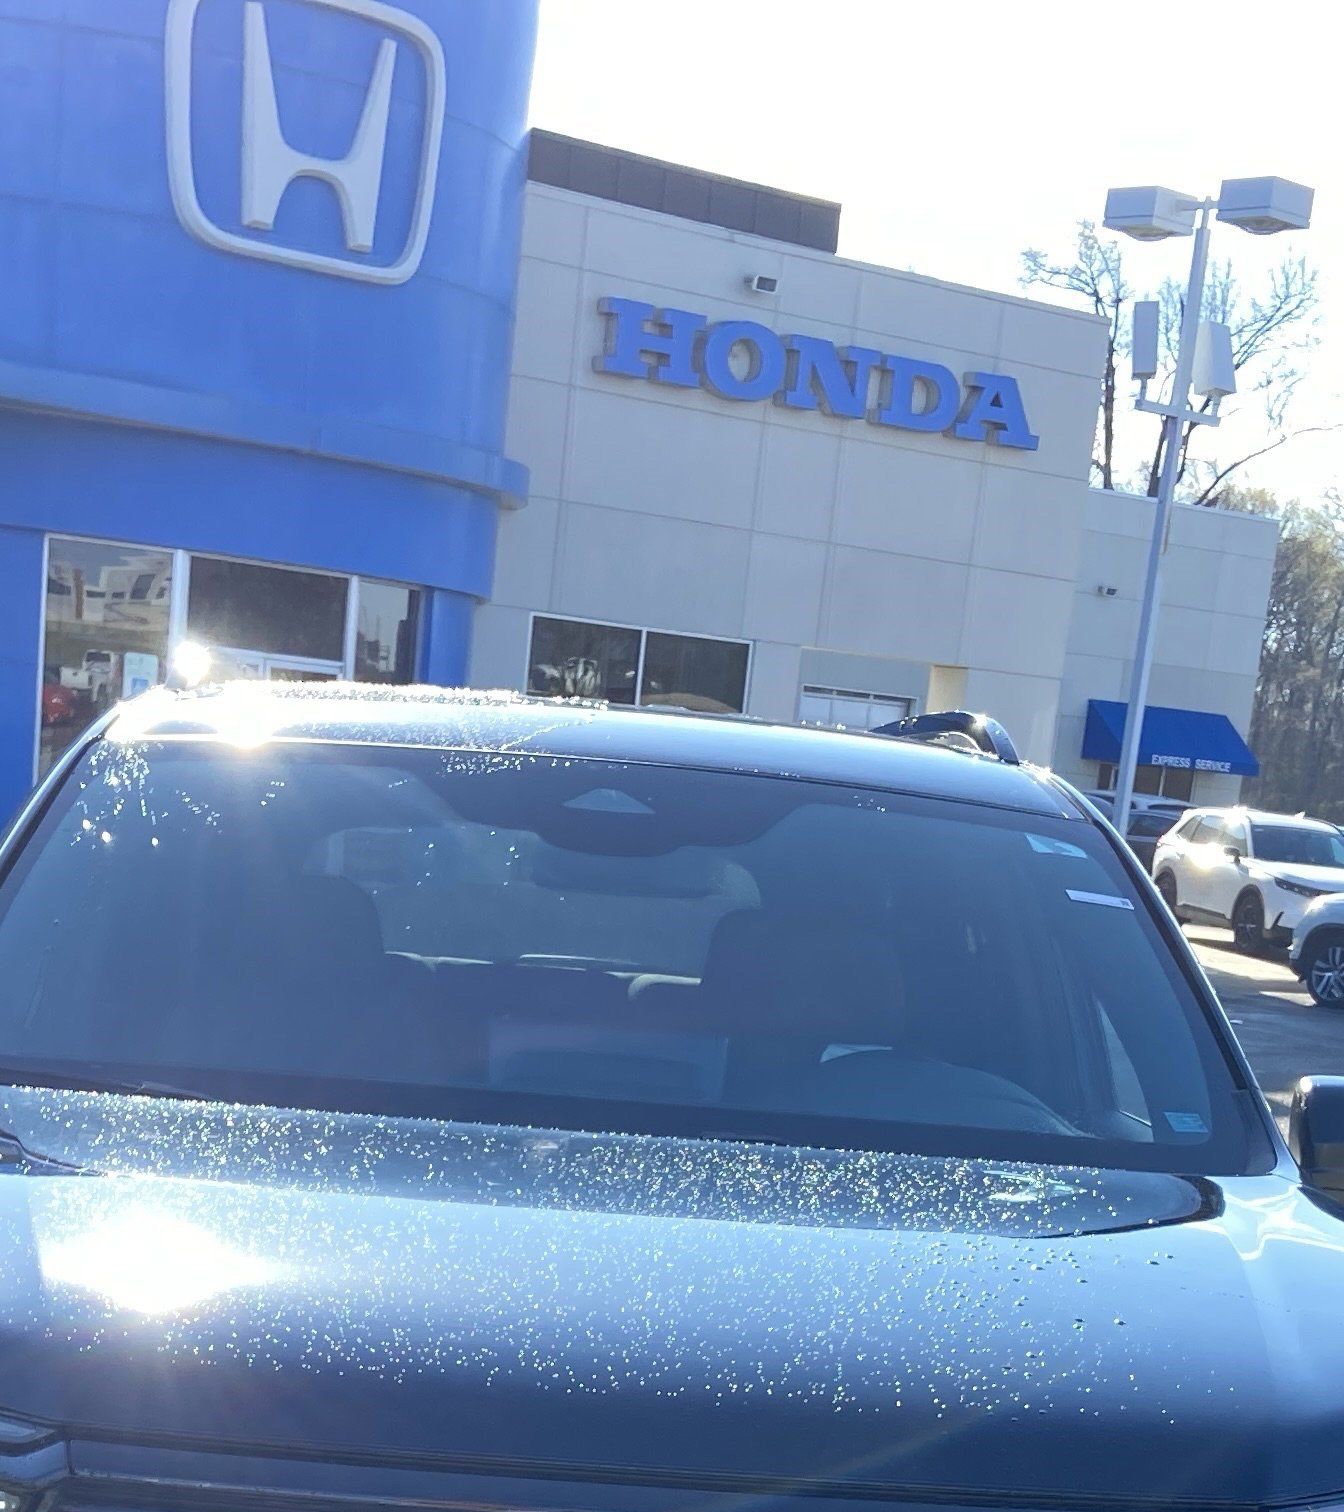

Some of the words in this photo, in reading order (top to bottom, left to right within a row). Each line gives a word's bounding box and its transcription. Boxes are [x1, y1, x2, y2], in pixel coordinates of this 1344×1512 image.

[593, 296, 1040, 451] HONDA
[1151, 754, 1191, 768] EXPRESS
[1195, 758, 1231, 772] SERVICE
